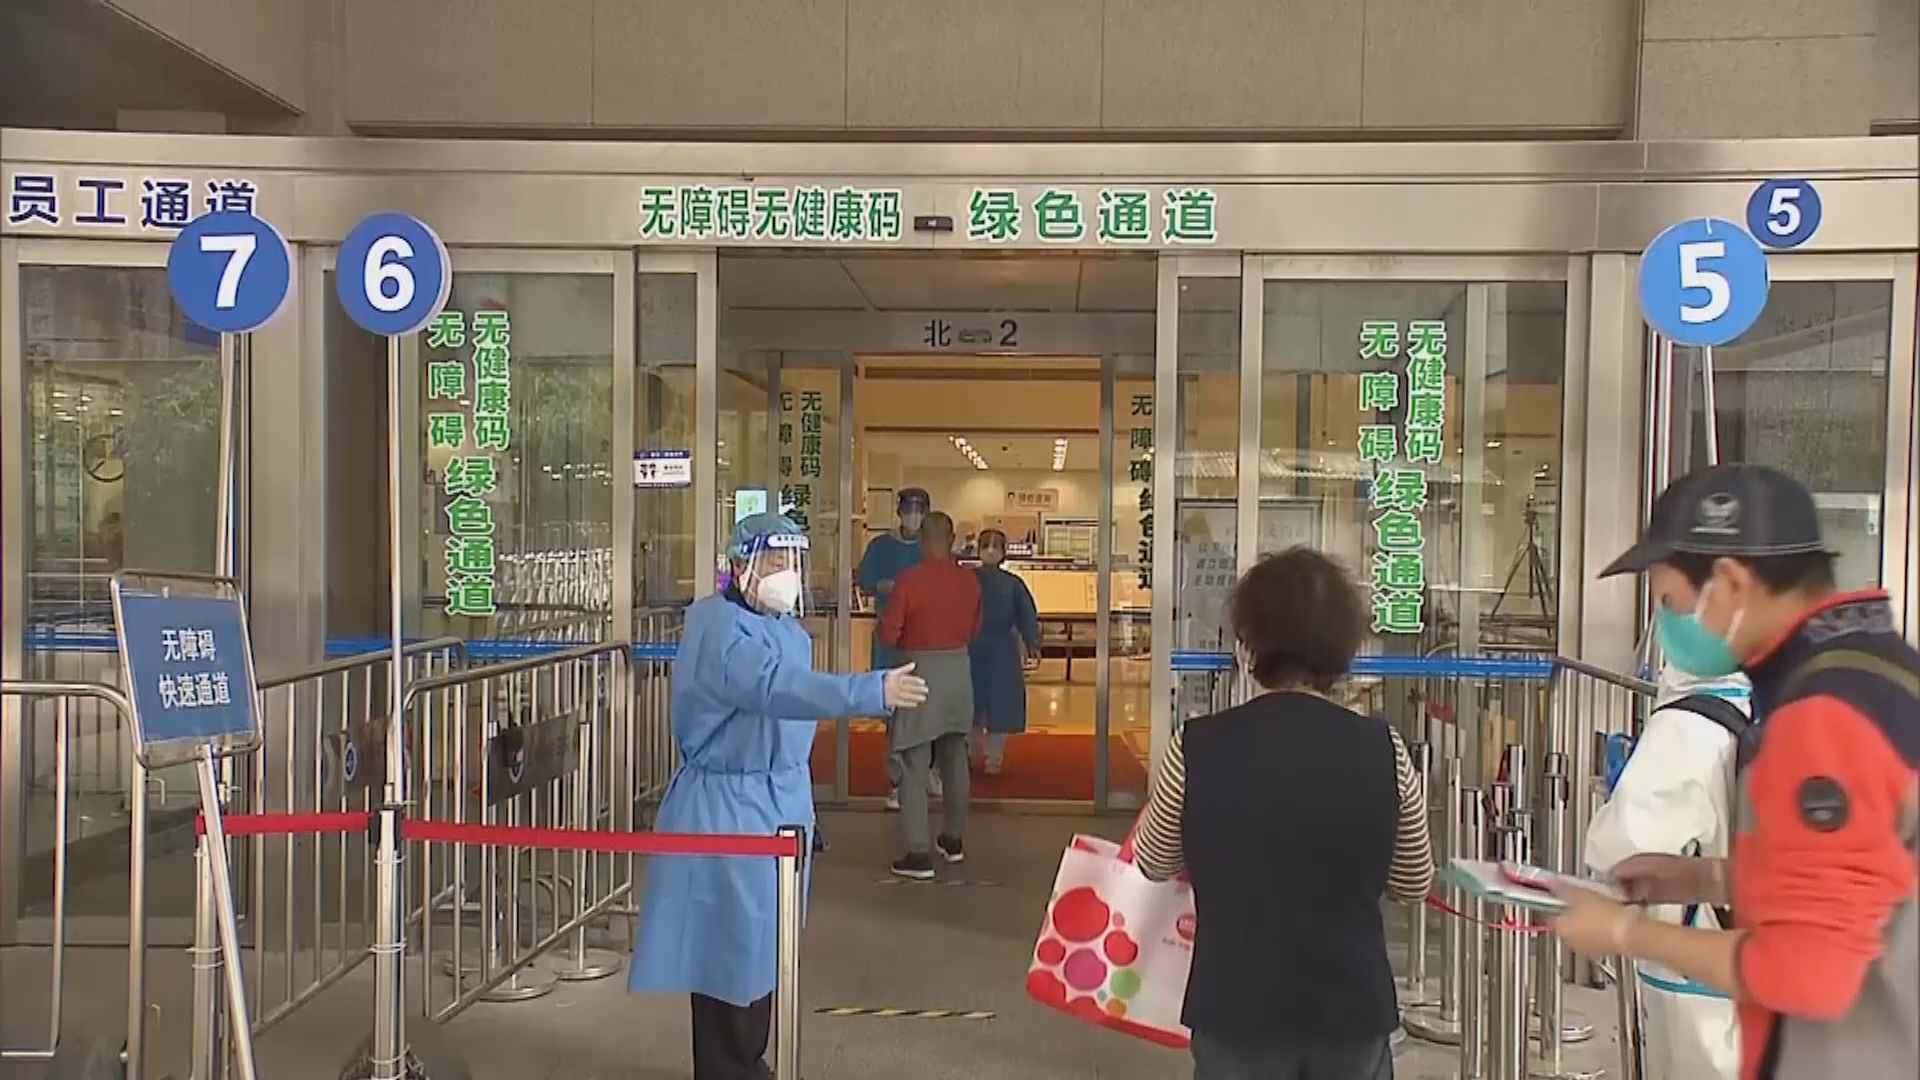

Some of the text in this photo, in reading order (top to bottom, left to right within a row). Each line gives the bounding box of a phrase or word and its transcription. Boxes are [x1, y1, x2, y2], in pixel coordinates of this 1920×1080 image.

[8, 175, 256, 228] 员工通道
[640, 186, 1217, 241] 无障碍无健康码 绿色通道
[1767, 188, 1803, 236] 5
[200, 233, 257, 308] 7
[363, 235, 416, 311] 6
[1678, 241, 1731, 323] 5
[923, 319, 1018, 347] 北 2
[428, 312, 465, 448] 无障碍
[474, 311, 511, 450] 无健康码
[1358, 321, 1398, 463] 无障碍
[1405, 321, 1446, 463] 无健康码
[800, 391, 822, 478] 无健康码
[445, 457, 495, 616] 绿色通道
[1373, 471, 1426, 634] 绿色通道
[161, 627, 216, 661] 无障碍
[158, 671, 232, 709] 快速通道
